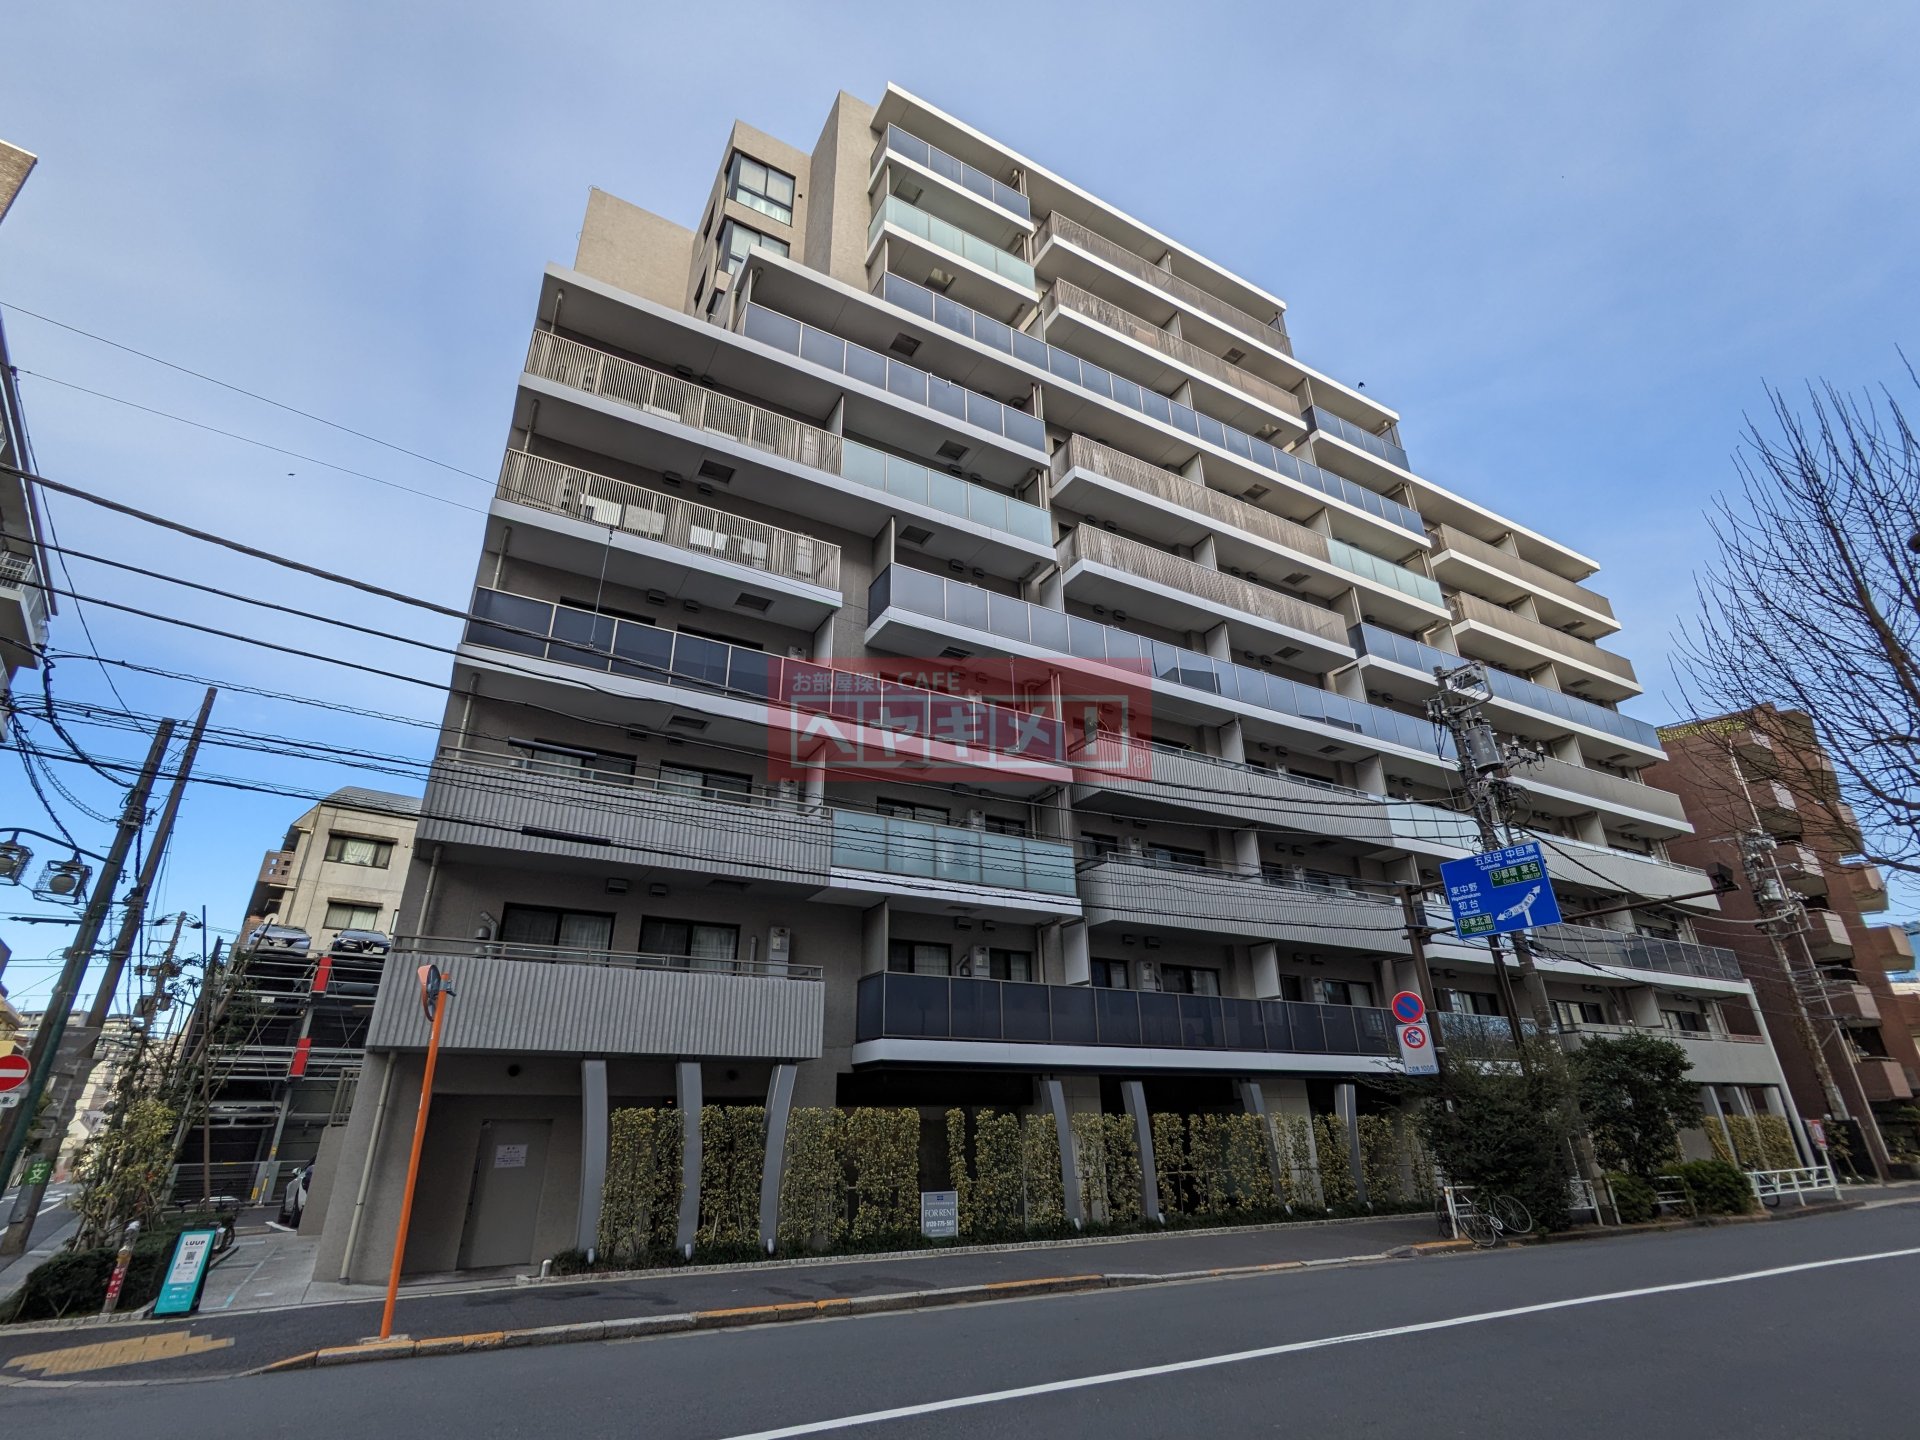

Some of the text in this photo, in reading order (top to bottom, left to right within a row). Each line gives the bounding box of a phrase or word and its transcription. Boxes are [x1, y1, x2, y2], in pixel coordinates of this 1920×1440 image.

[1474, 845, 1536, 866] 五反田 中目黒
[1480, 854, 1539, 871] Gotanda Nakameguro
[1520, 863, 1538, 874] 東名
[1450, 882, 1478, 896] 東中野
[1451, 892, 1482, 902] Higashinakano
[1458, 899, 1479, 910] 初台
[1469, 915, 1492, 926] 東北道
[924, 1208, 955, 1218] FOR RENT
